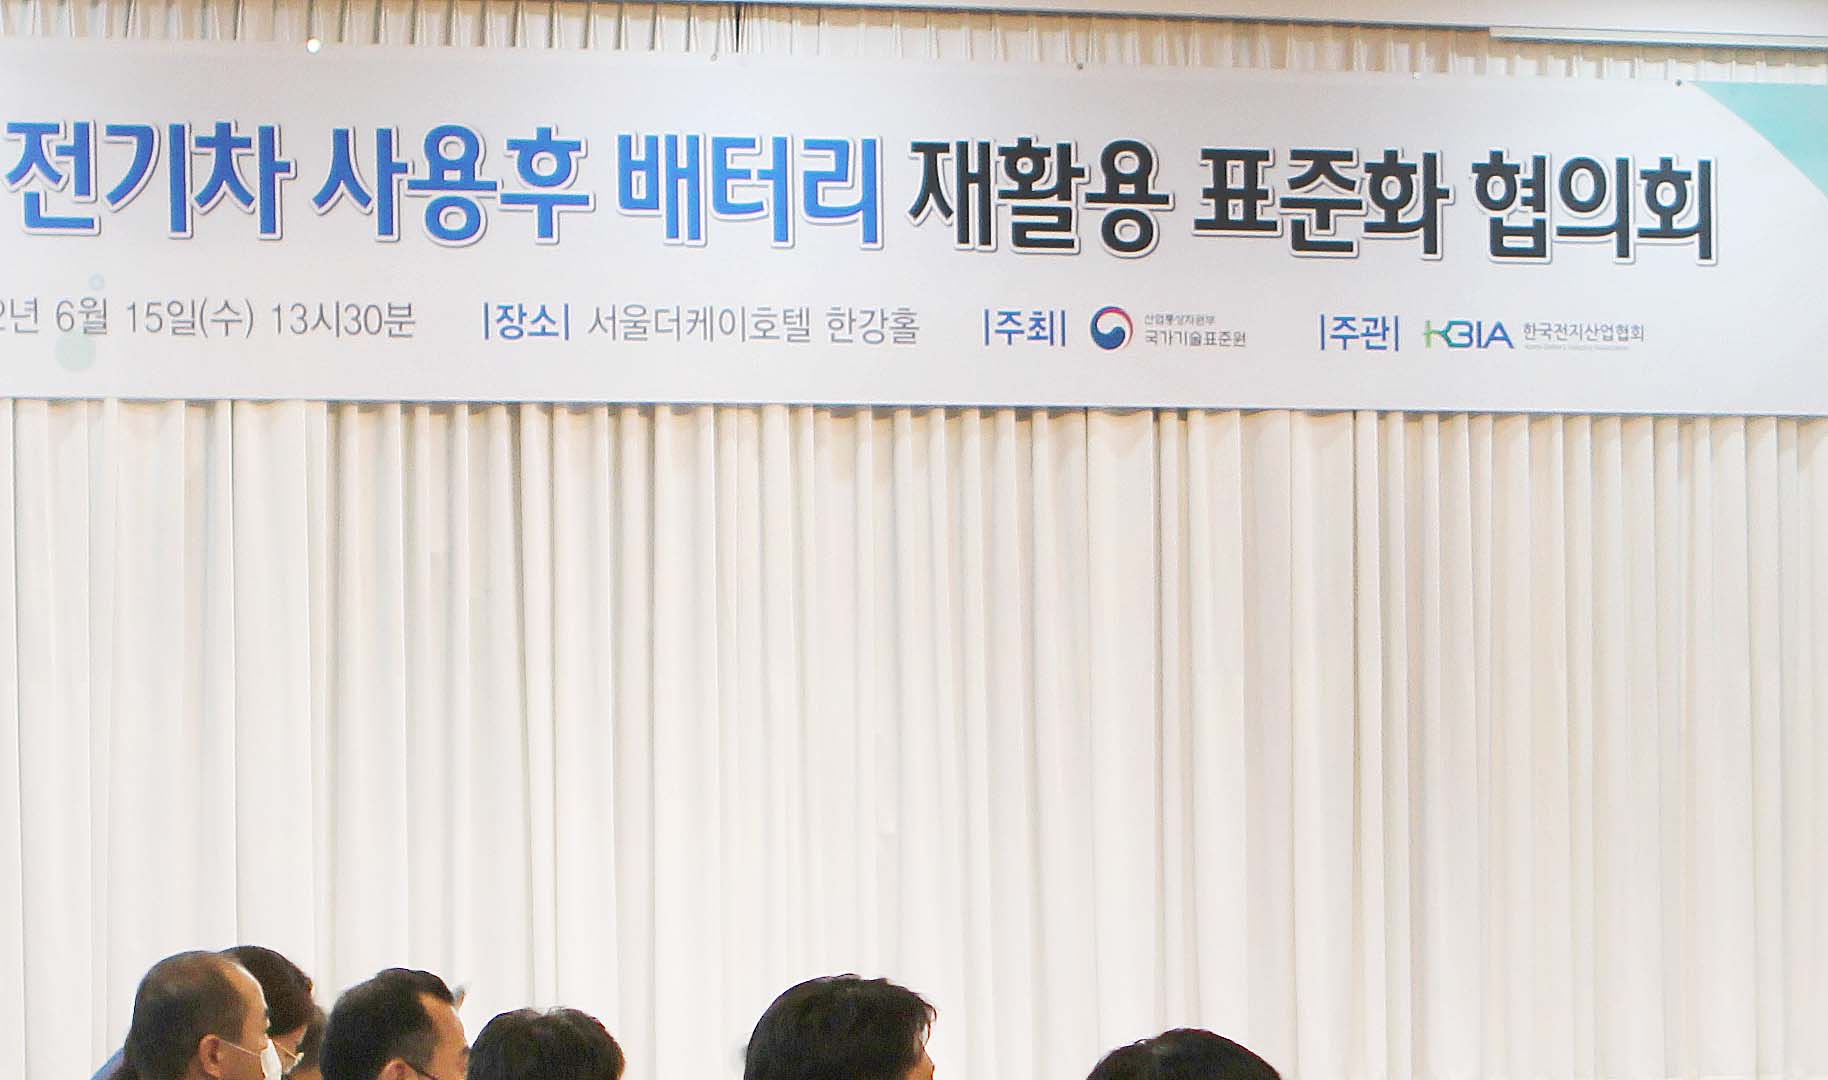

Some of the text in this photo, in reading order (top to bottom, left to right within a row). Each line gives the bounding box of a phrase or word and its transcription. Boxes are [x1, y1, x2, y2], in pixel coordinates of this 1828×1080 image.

[4, 121, 1713, 260] 전기차 사용후 배터리 재활용 표준화 협의회
[55, 296, 108, 335] 6월
[127, 297, 254, 338] 15일(수)
[272, 299, 416, 338] 13시30분
[588, 303, 812, 343] 서울더케이호텔
[825, 305, 920, 345] 한강홀
[1522, 321, 1645, 343] 한국전지산업협회
[1145, 329, 1247, 348] 국가기술표준원
